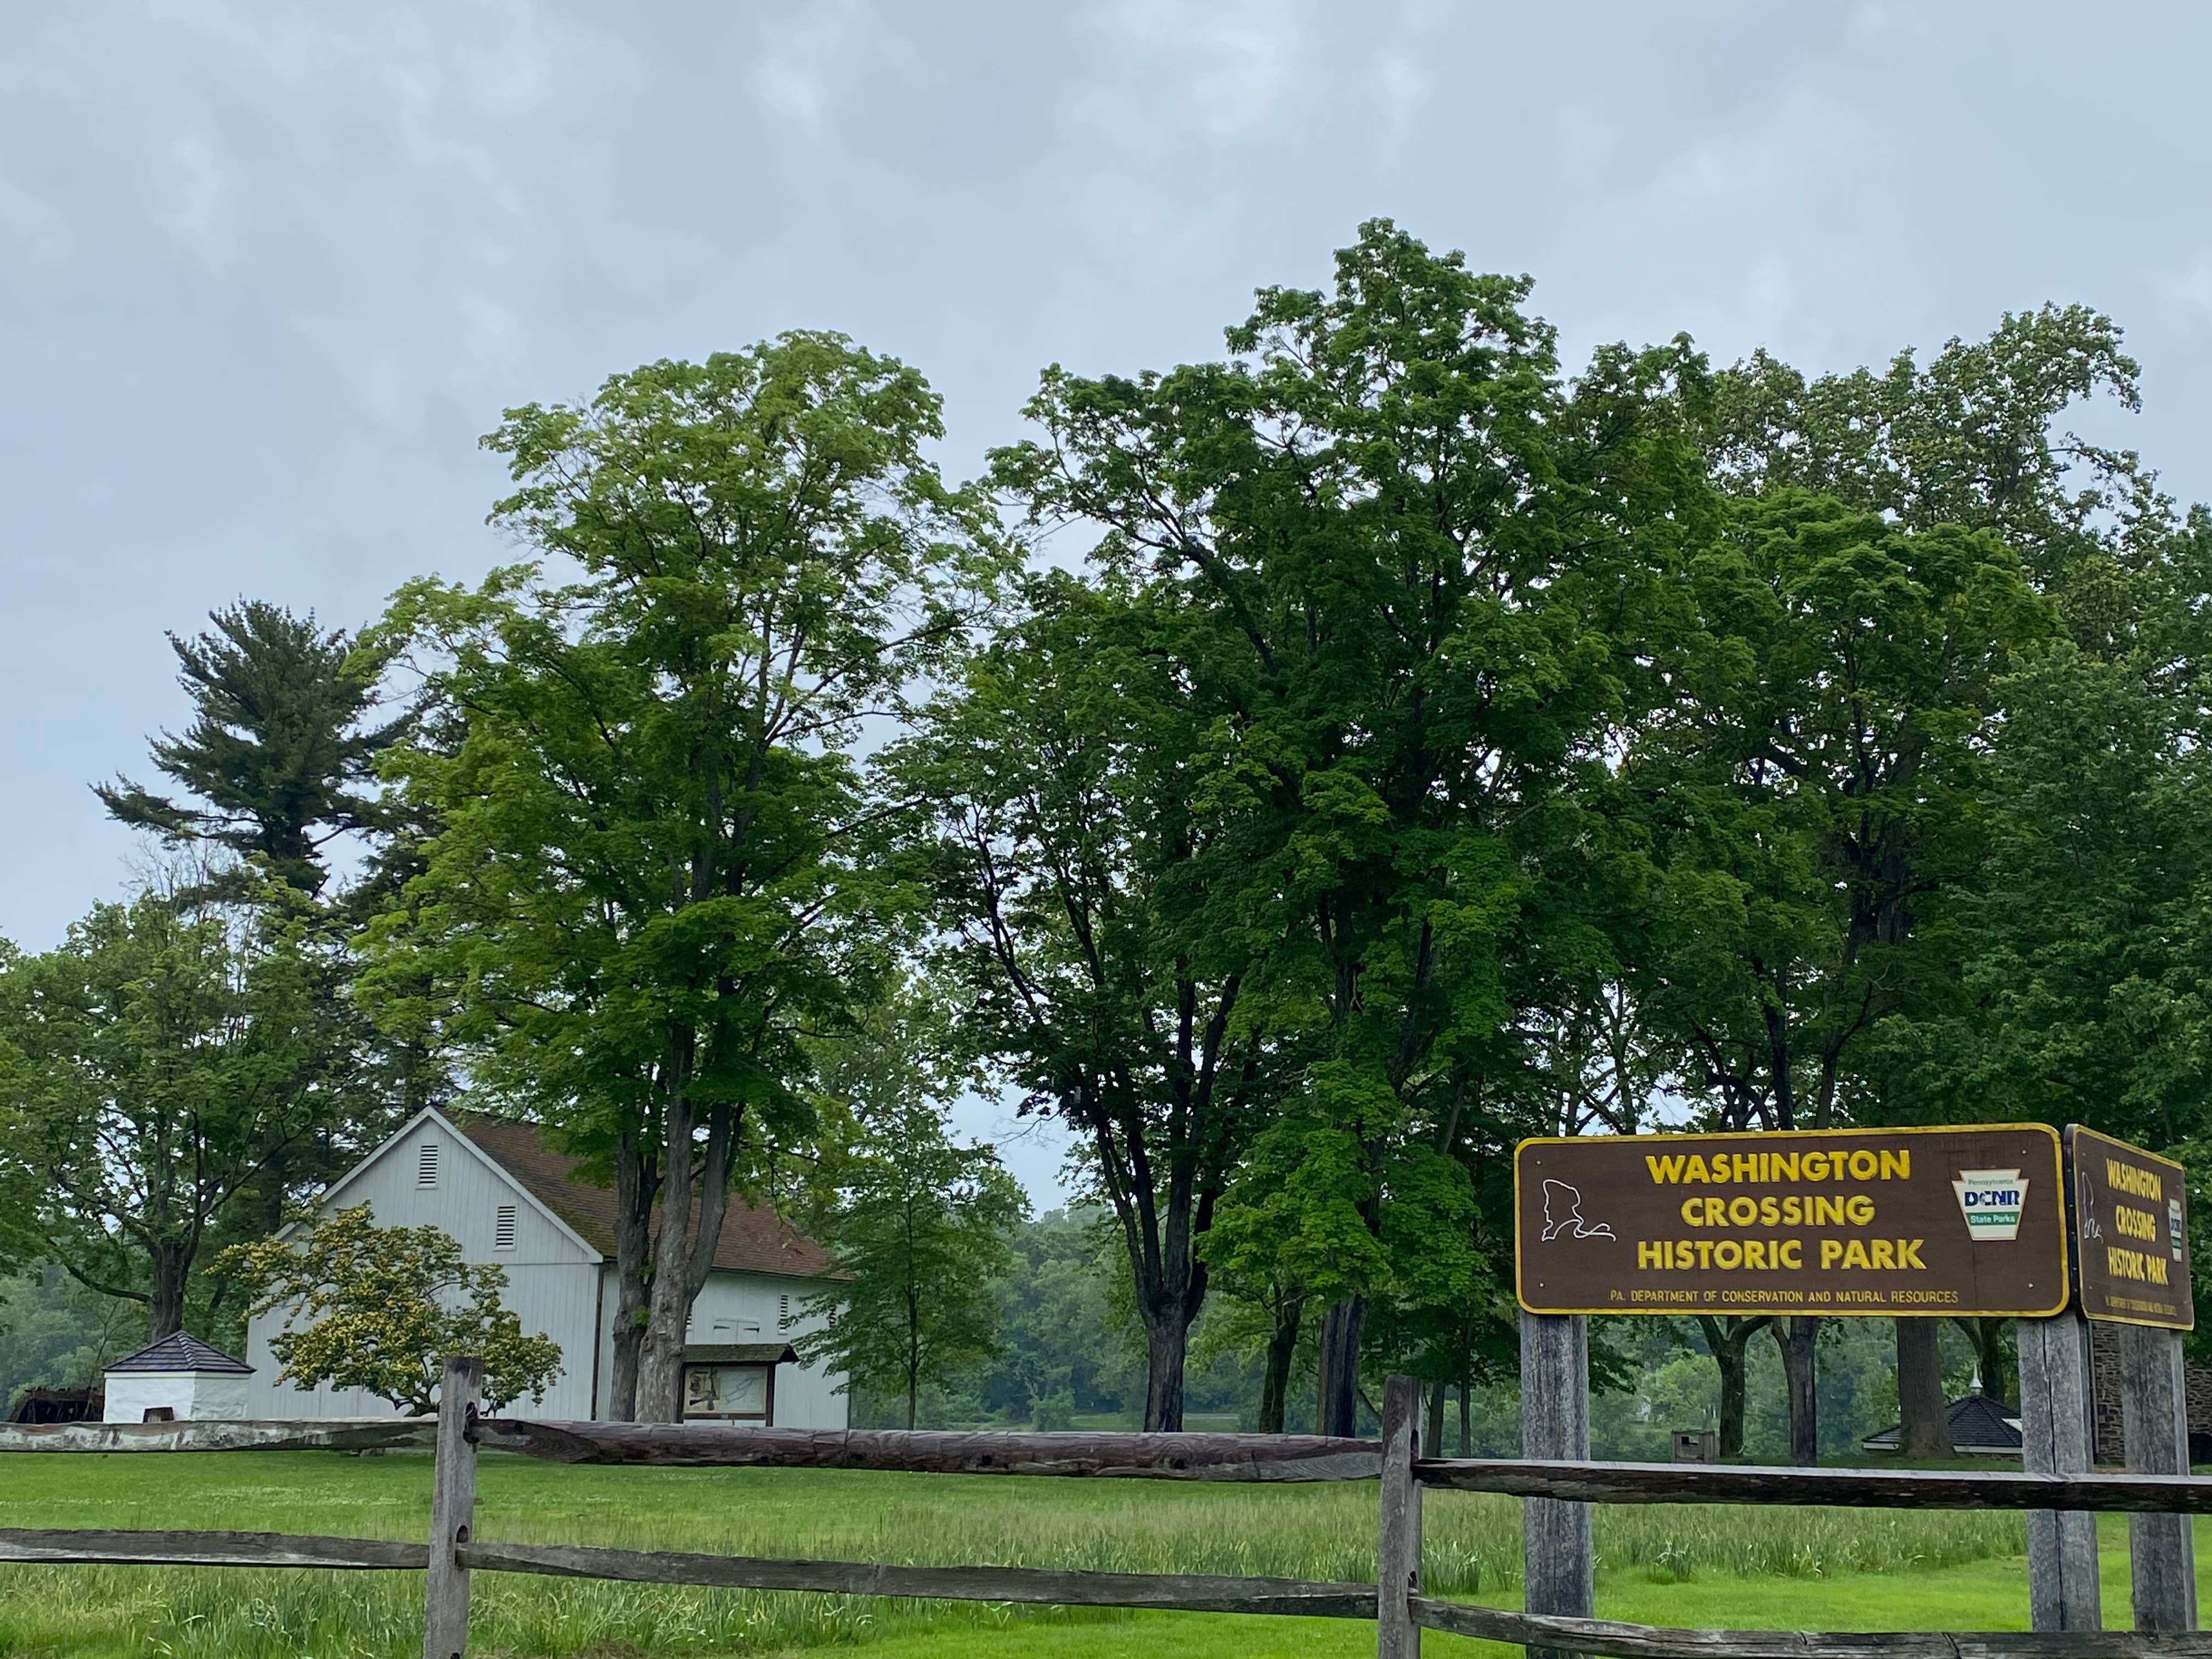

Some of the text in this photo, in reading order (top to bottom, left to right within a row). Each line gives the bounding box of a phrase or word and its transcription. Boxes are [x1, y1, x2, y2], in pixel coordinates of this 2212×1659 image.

[1646, 1150, 1910, 1184] WASHINGTON
[2106, 1158, 2162, 1203] WASHINGTON
[1680, 1195, 1876, 1227] CROSSING
[1964, 1190, 2020, 1206] DCNR
[1970, 1214, 2016, 1223] State Parks
[2115, 1205, 2157, 1242] CROSSING
[1638, 1239, 1927, 1270] HISTORIC PARK
[2107, 1246, 2169, 1286] HISTORIC PARK
[1610, 1289, 1959, 1304] PA. DEPARTMENT OF CONSERVATION AND NATURAL RESOURCES
